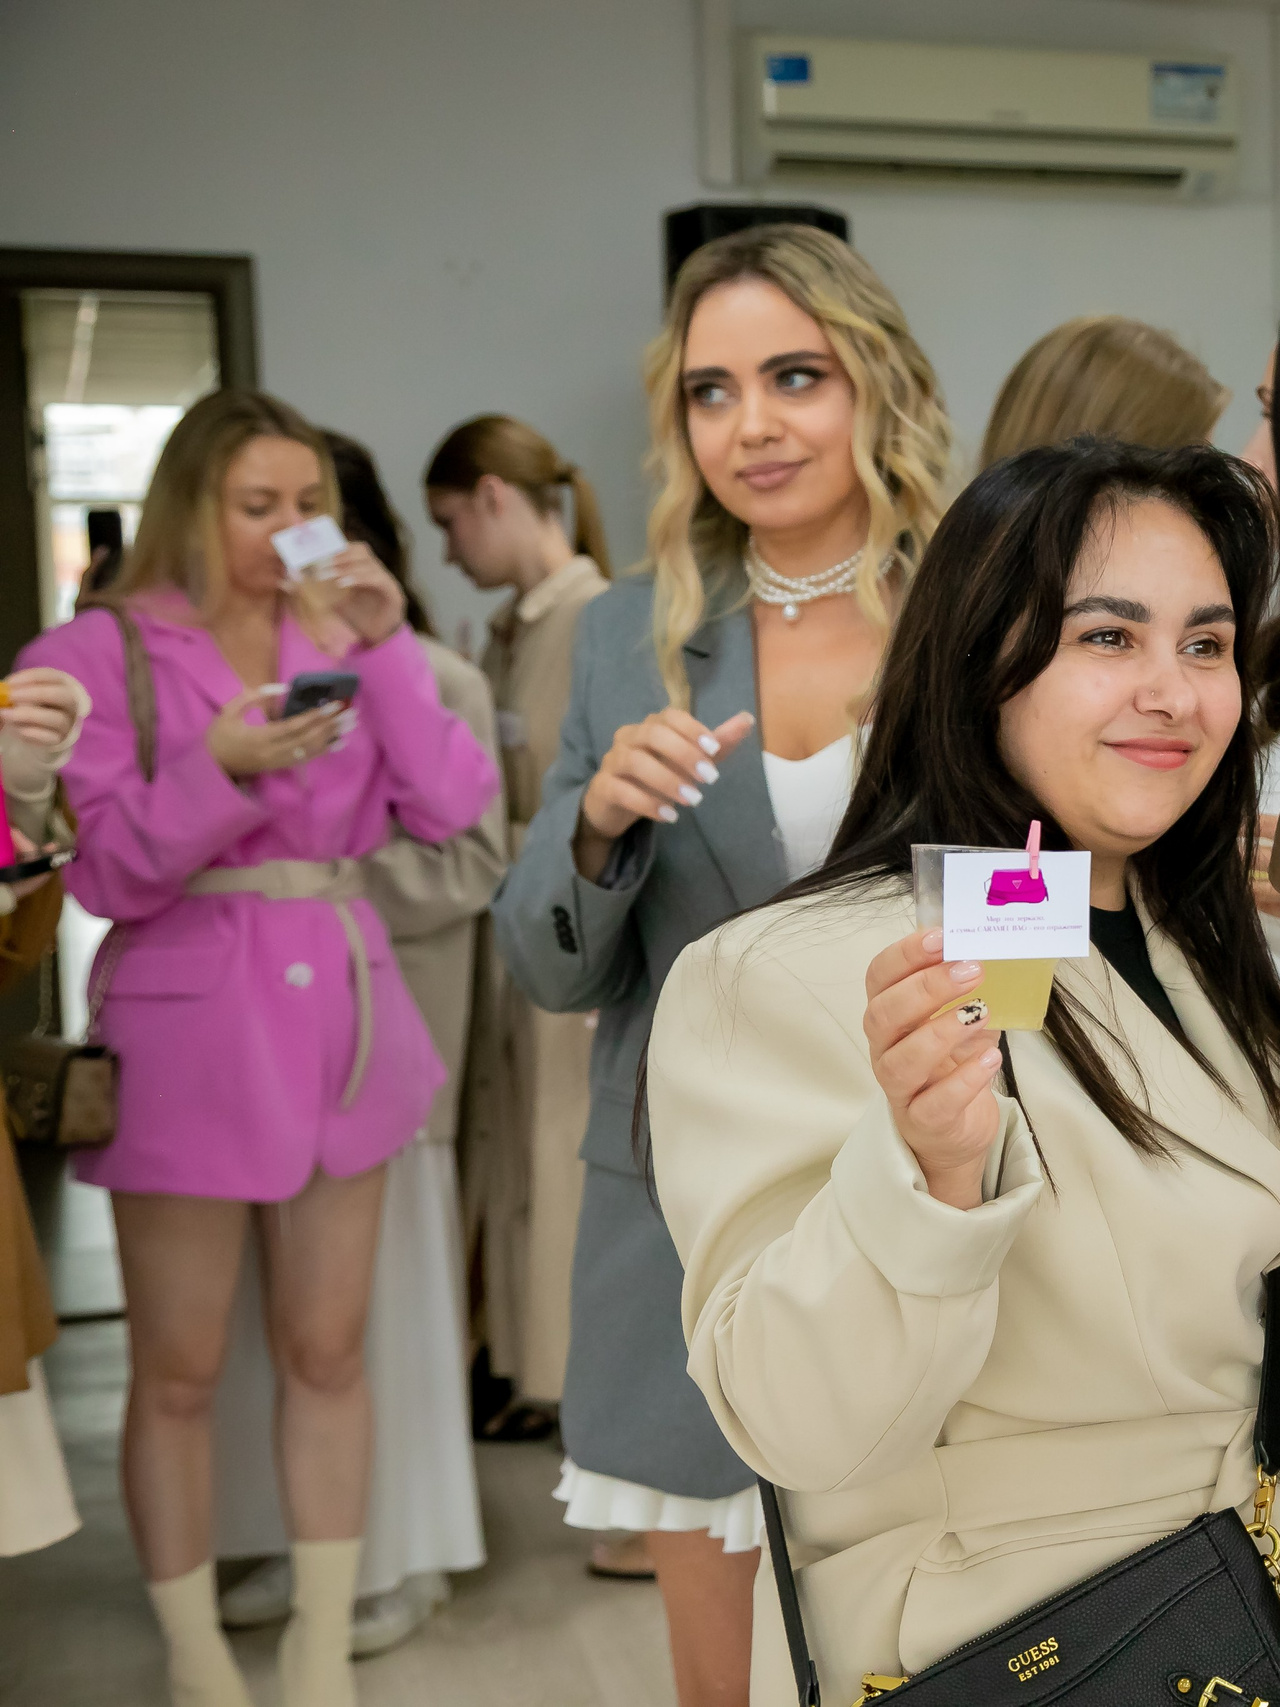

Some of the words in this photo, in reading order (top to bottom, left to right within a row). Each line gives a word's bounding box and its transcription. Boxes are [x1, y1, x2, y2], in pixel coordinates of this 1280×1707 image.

[1008, 1636, 1059, 1672] GUESS
[1018, 1666, 1038, 1682] EST
[1039, 1655, 1060, 1671] 1981
